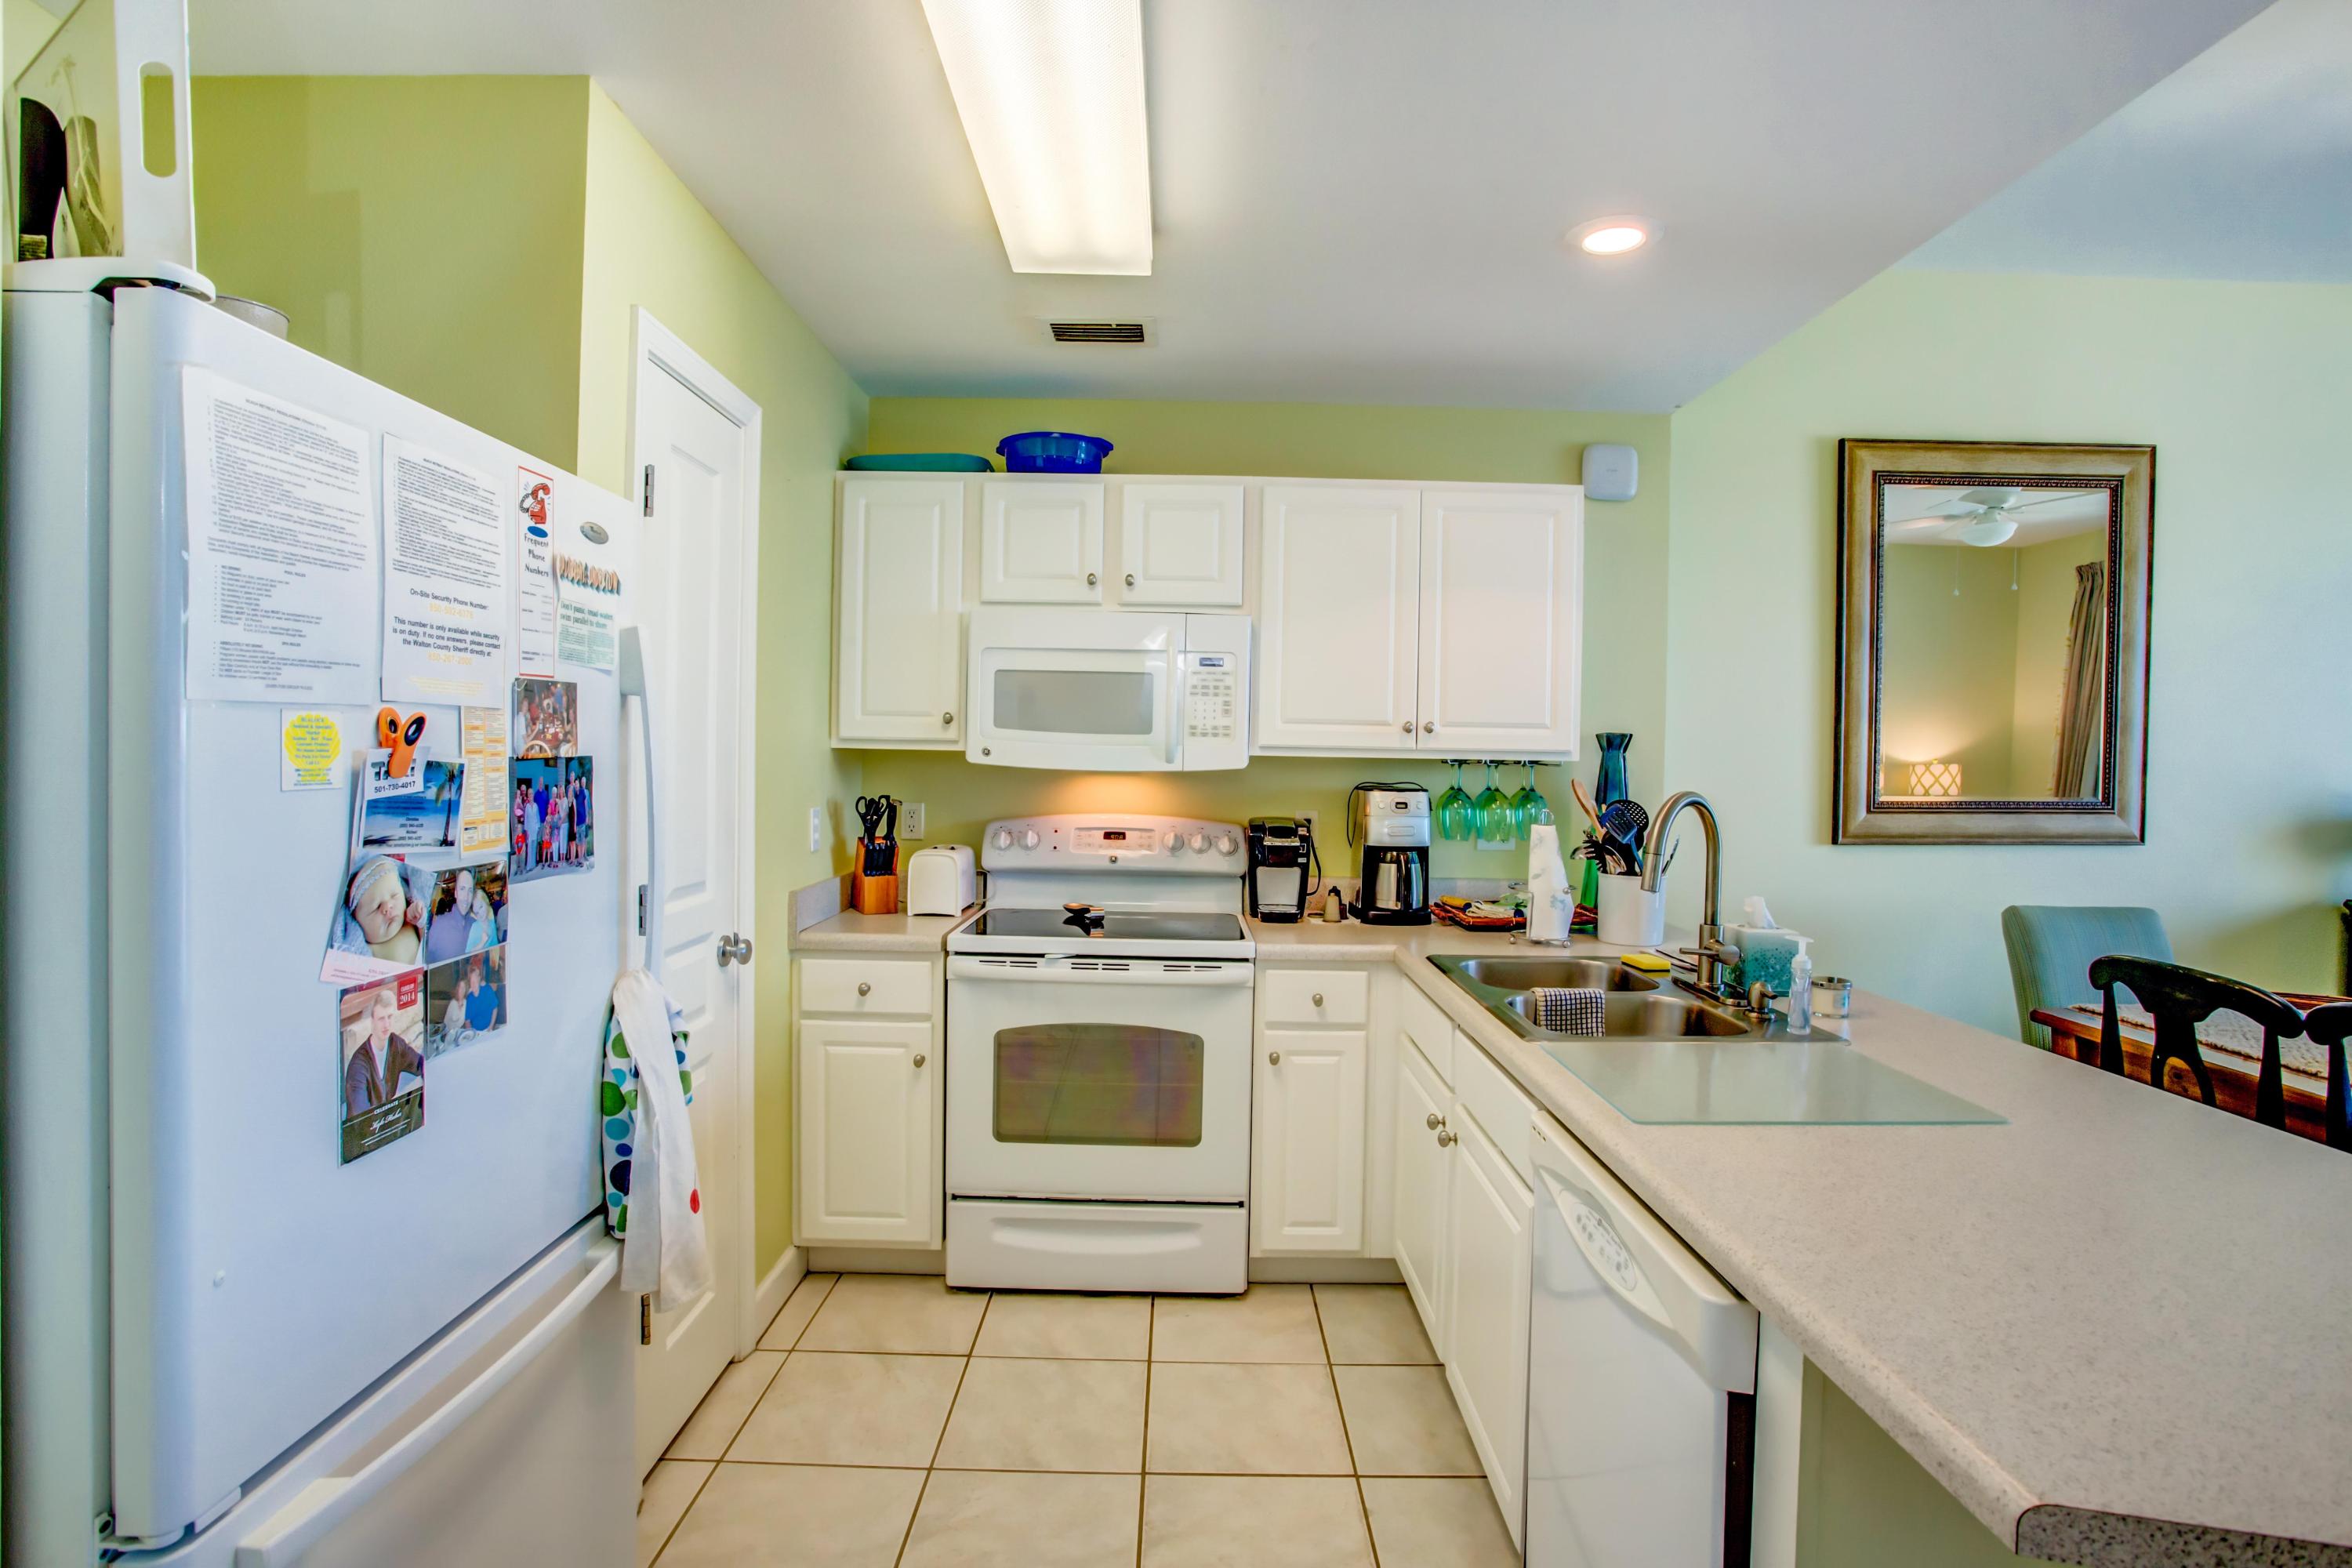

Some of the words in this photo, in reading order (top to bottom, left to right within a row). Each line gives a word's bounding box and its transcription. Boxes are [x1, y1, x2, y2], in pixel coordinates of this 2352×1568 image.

[524, 533, 549, 548] Frequent
[528, 549, 545, 562] Phone
[524, 563, 549, 577] Numbers
[410, 588, 430, 598] On-Site
[431, 593, 452, 604] Security
[453, 597, 469, 606] Phone
[394, 616, 406, 625] This
[408, 620, 428, 629] number
[435, 624, 447, 633] only
[448, 626, 469, 636] available
[470, 629, 482, 637] while
[483, 632, 500, 641] security
[413, 639, 432, 648] Walton
[433, 643, 452, 652] County
[452, 645, 469, 654] Sheriff
[470, 648, 485, 657] directly
[470, 638, 485, 647] please
[374, 781, 416, 793] 501-730-4017
[399, 993, 415, 1004] 2014
[374, 1100, 399, 1114] CELEBRATE
